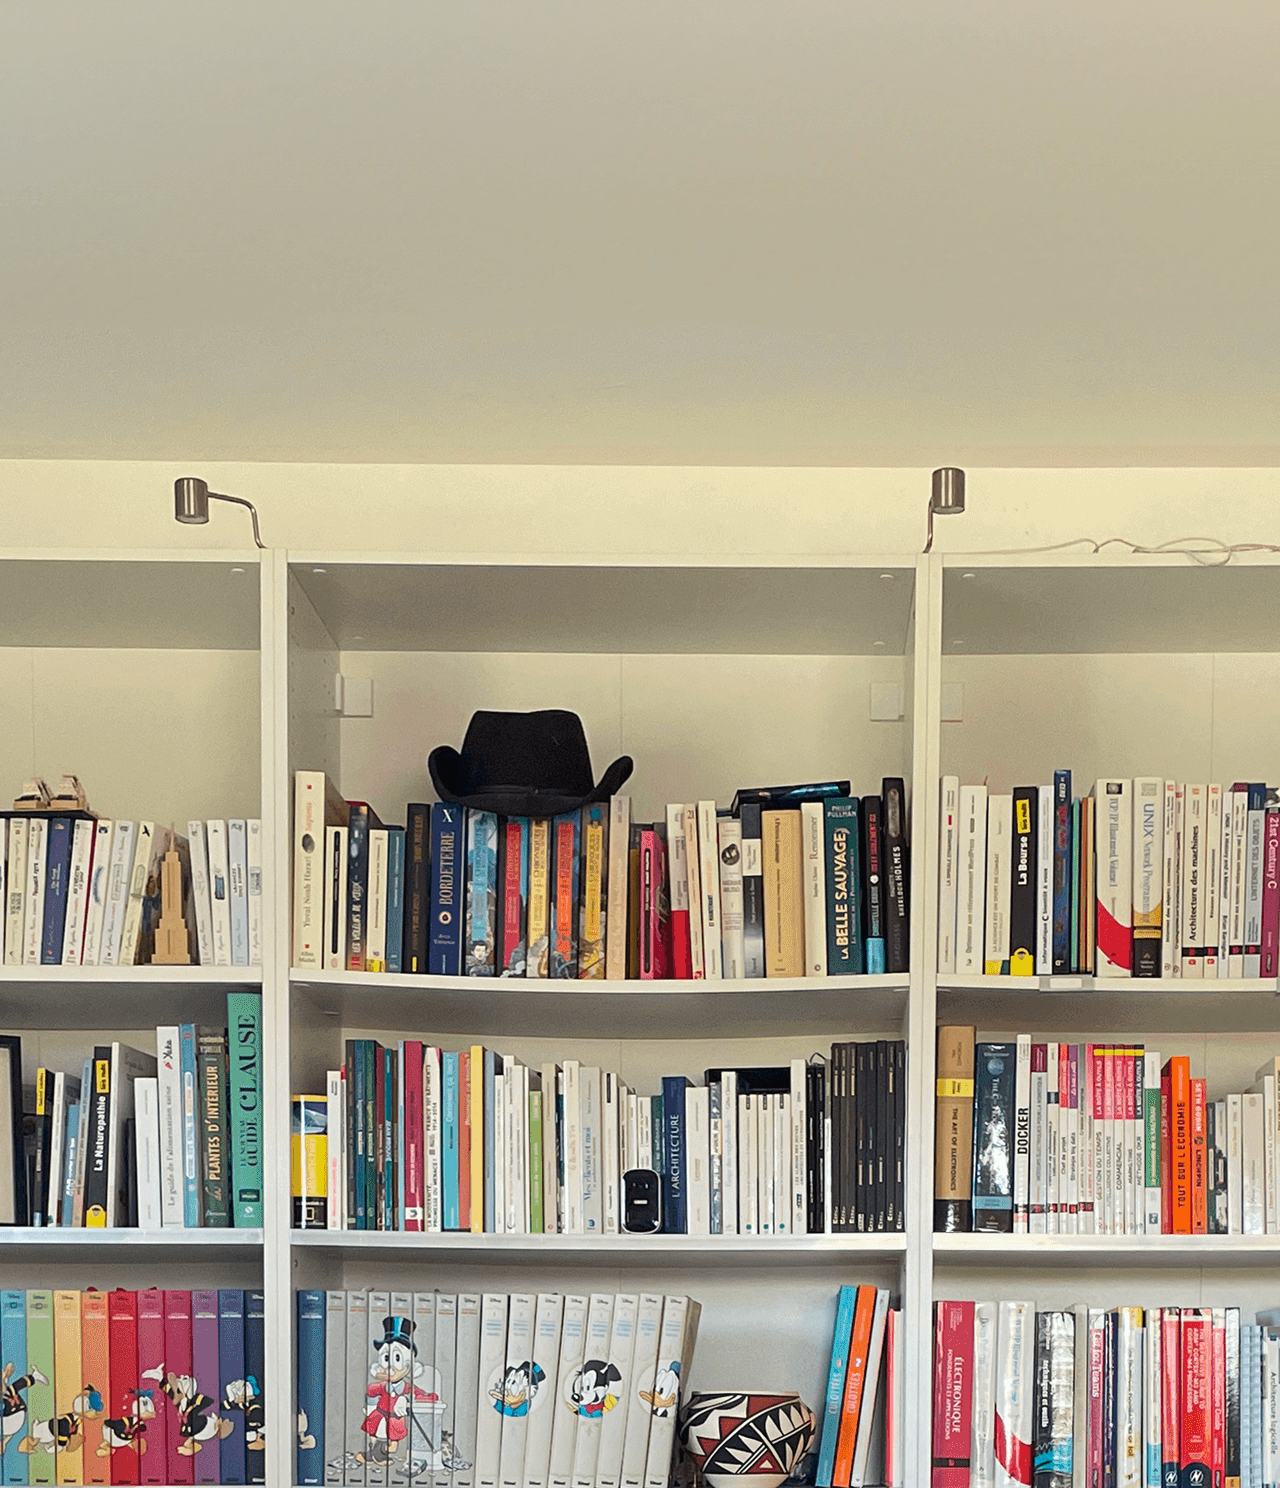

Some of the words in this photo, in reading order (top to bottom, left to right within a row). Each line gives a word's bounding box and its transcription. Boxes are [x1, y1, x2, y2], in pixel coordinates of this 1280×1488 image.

[1143, 803, 1154, 837] UNIX
[1269, 817, 1279, 837] 21st
[893, 846, 902, 880] HOLMES
[1018, 837, 1028, 871] Bourse
[1191, 826, 1199, 867] machines
[1267, 839, 1279, 879] Century
[439, 832, 454, 905] BORDETERRE
[834, 833, 847, 900] SAUVAGE
[1018, 873, 1027, 885] La
[1190, 870, 1198, 885] des
[1268, 881, 1277, 889] C
[303, 906, 311, 927] Yuval
[836, 904, 848, 945] BELLE
[1189, 888, 1197, 941] Architecture
[352, 941, 360, 953] LES
[841, 948, 849, 959] LA
[237, 1014, 258, 1111] CLAUSE
[204, 1066, 219, 1131] D'INTÉRIEUR
[95, 1096, 106, 1157] Naturopathie
[166, 1108, 174, 1160] l'alimentation
[247, 1118, 258, 1166] GUIDE
[951, 1137, 958, 1145] OF
[1017, 1108, 1029, 1154] DOCKER
[94, 1160, 103, 1171] La
[208, 1136, 221, 1180] PLANTES
[670, 1115, 680, 1197] L'ARCHITECTURE
[950, 1148, 958, 1191] ELECTRONICS
[1096, 1160, 1102, 1170] DU
[1177, 1162, 1186, 1180] SUR
[167, 1174, 177, 1194] guide
[1177, 1185, 1186, 1208] TOUT
[951, 1357, 964, 1433] ÉLECTRONIQUE
[1091, 1364, 1103, 1398] Teams
